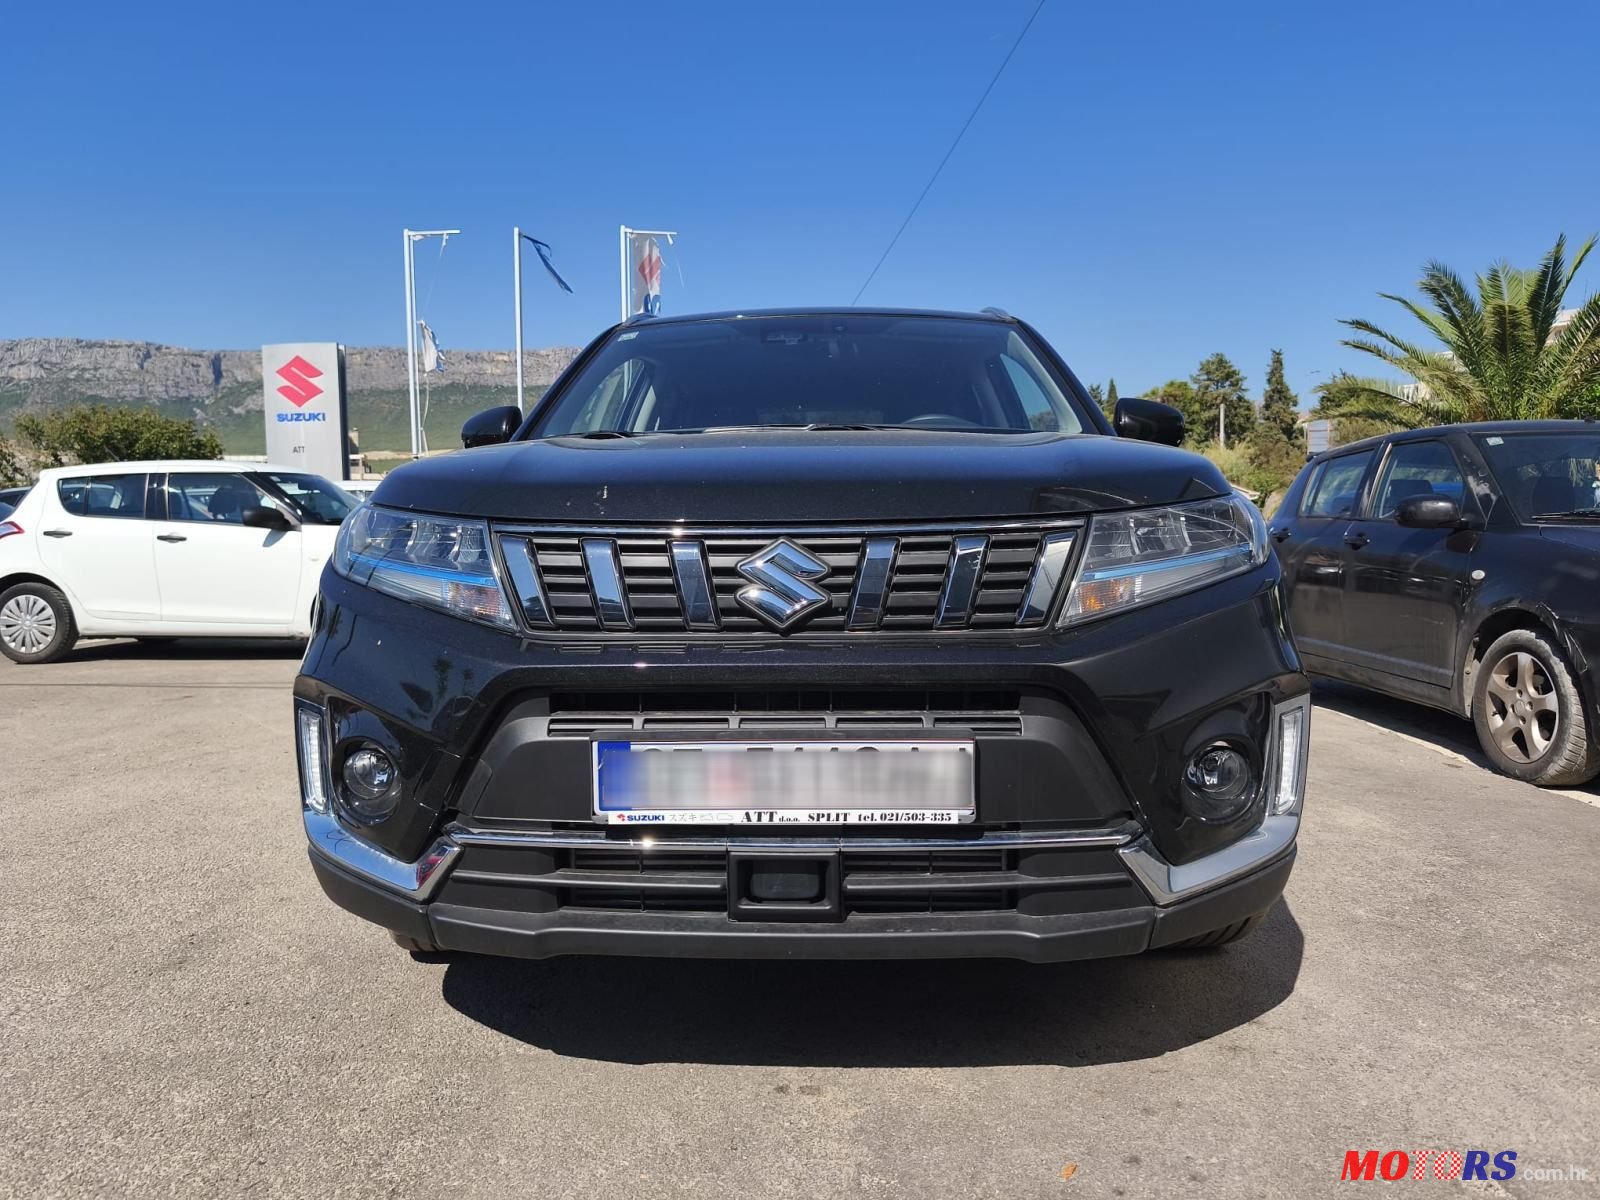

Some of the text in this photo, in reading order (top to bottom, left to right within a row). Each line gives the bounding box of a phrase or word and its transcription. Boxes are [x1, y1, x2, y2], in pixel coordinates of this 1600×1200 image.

[276, 412, 326, 422] SUZUKI
[627, 814, 665, 822] SUZUKI
[741, 811, 778, 822] ATT
[808, 812, 850, 822] SPLIT
[857, 812, 877, 822] tel.
[880, 812, 952, 822] 021/503-335
